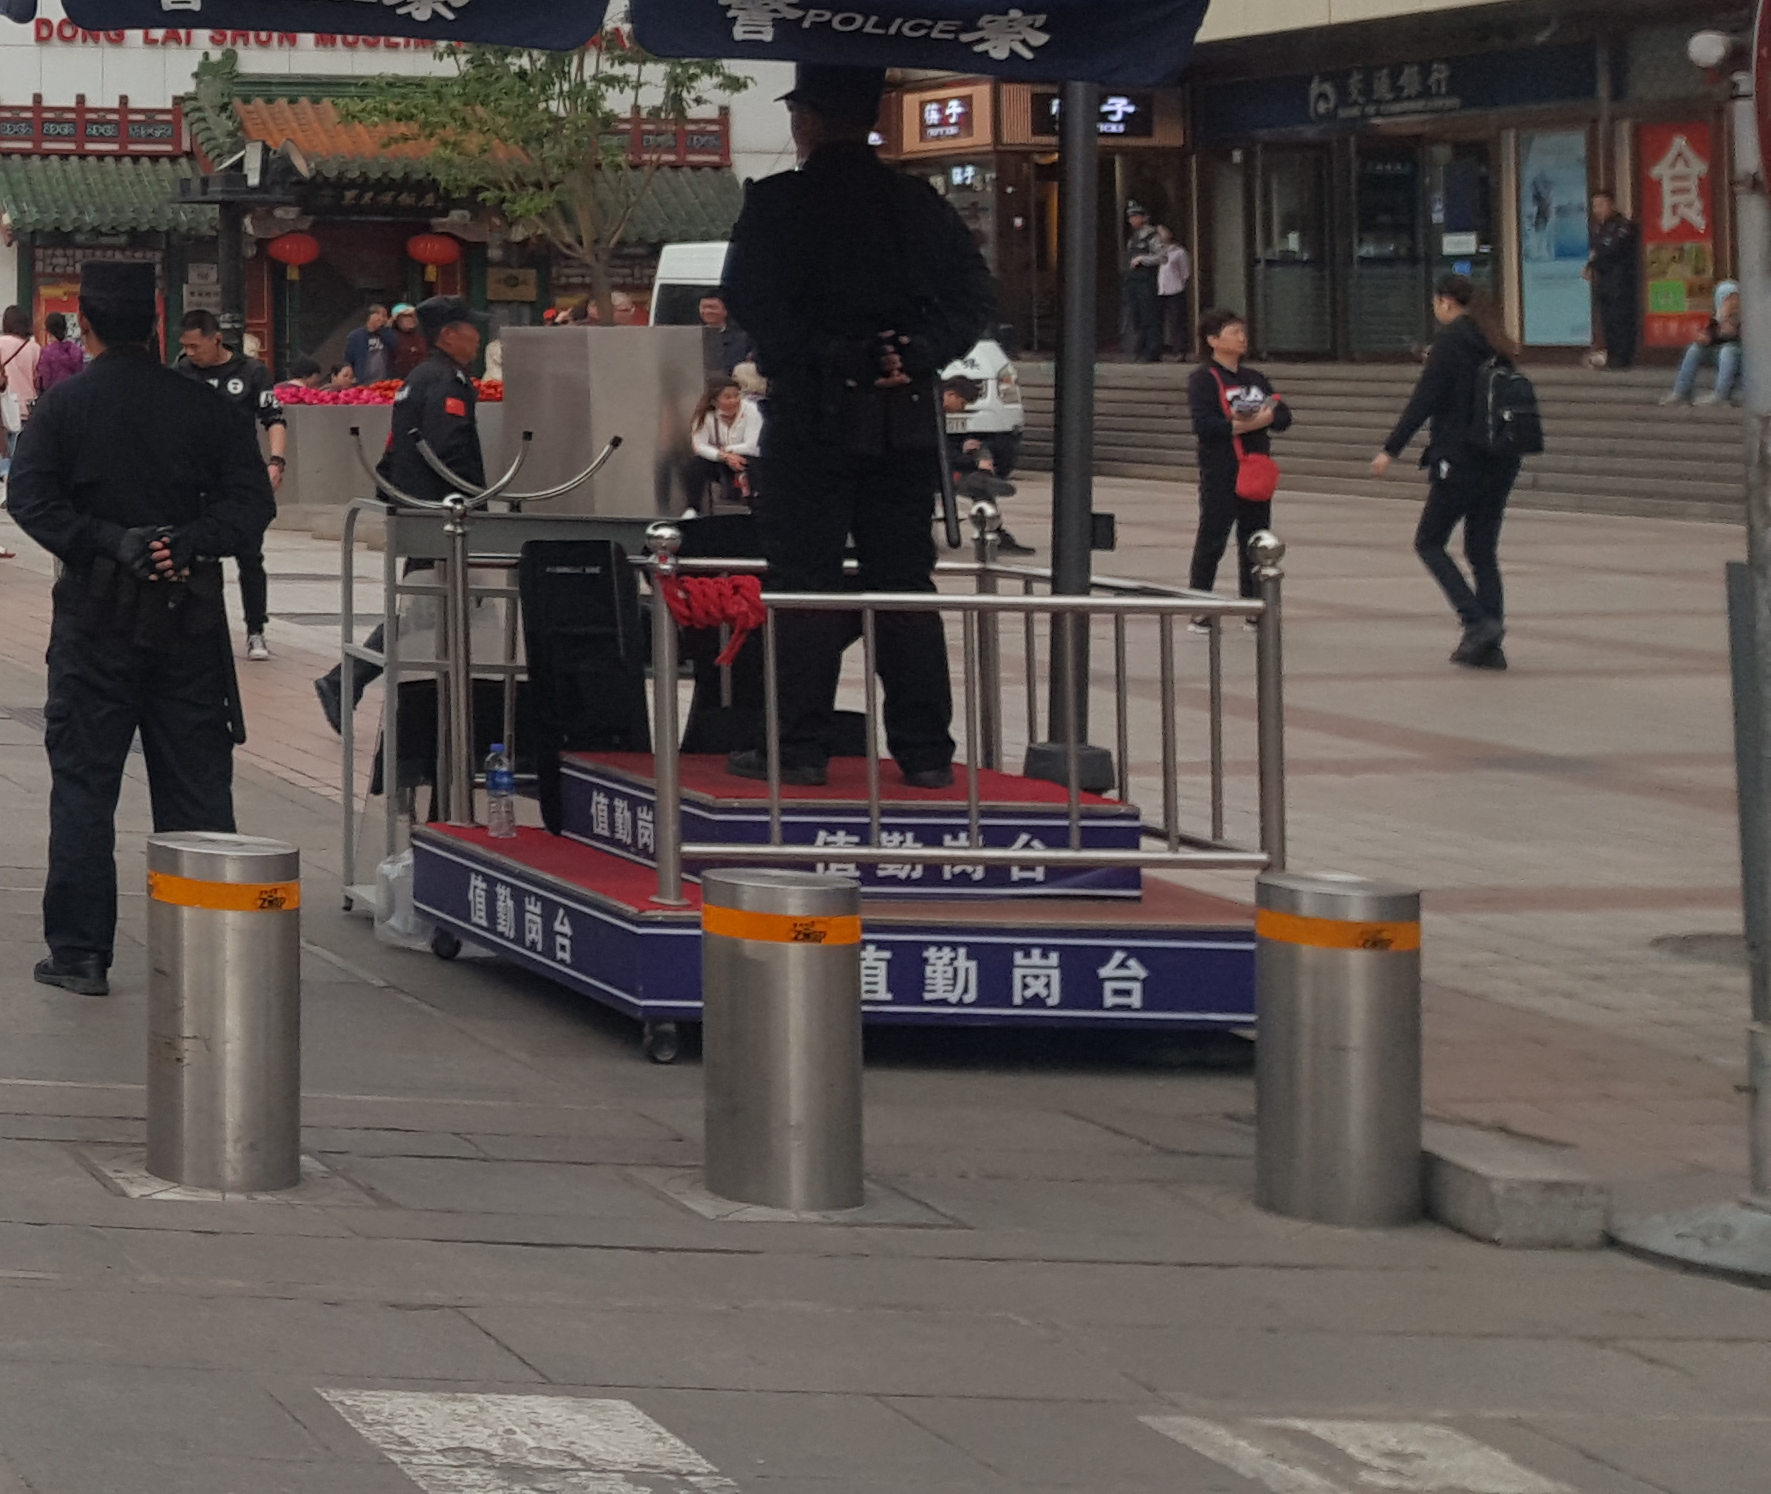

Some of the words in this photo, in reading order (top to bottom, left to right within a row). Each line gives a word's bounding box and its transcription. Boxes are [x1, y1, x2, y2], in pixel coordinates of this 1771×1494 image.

[34, 17, 125, 44] DONG
[142, 28, 193, 46] LAI
[209, 28, 298, 47] SHUN
[802, 9, 963, 40] POLICE
[960, 9, 1051, 61] 察
[1649, 133, 1709, 235] 食
[814, 830, 1047, 883] 值勤岗台
[468, 872, 574, 965] 值勤岗台
